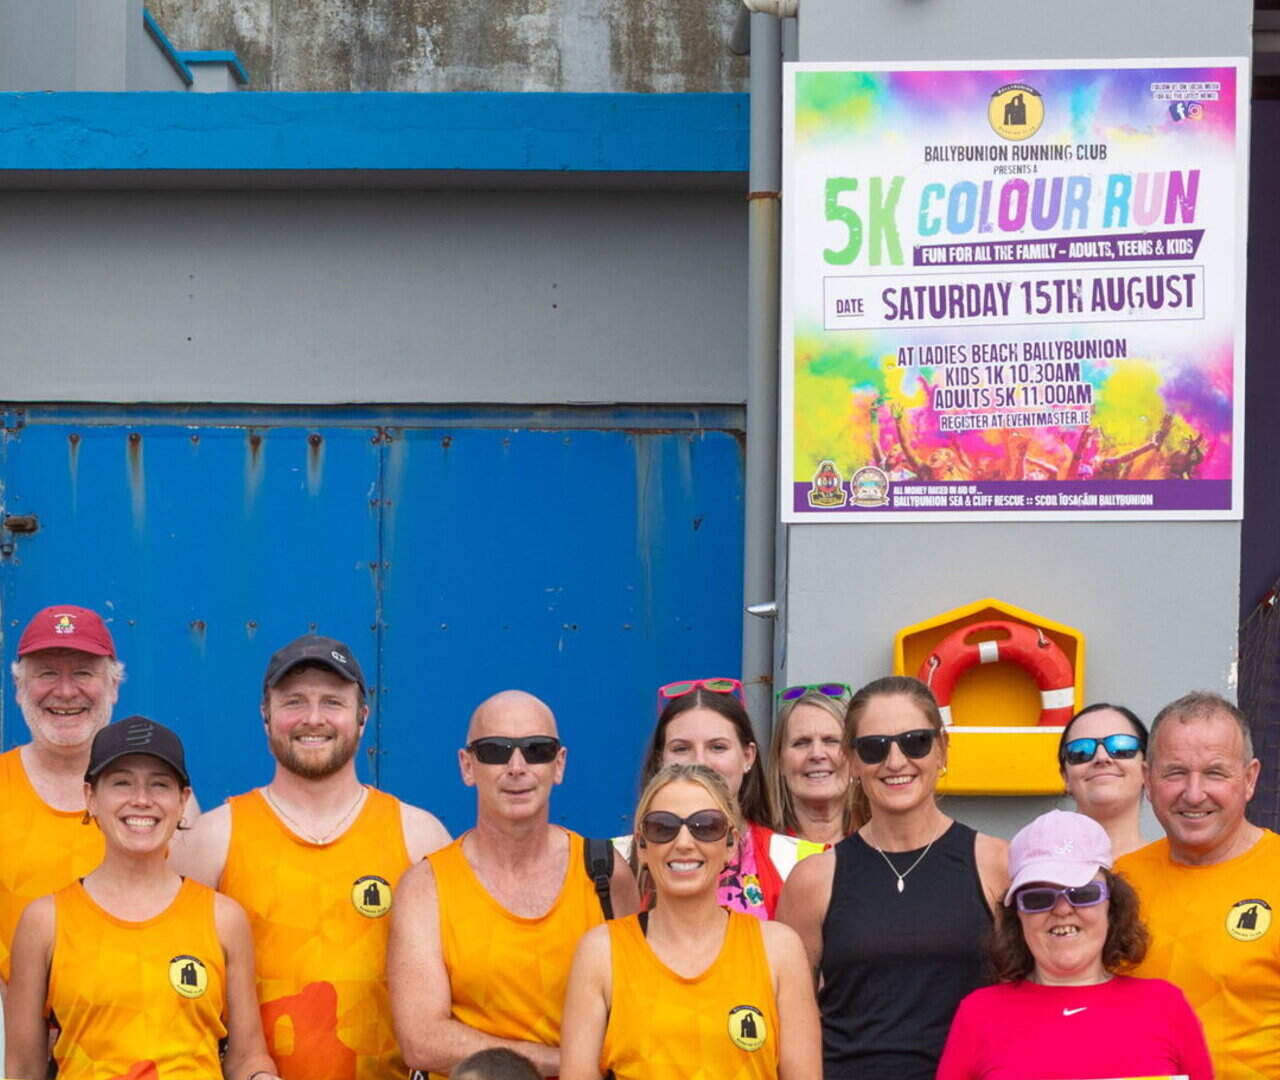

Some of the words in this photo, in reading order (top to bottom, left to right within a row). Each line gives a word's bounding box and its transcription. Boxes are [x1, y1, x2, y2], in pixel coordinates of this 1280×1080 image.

[924, 145, 1008, 162] BALLYBUNION
[1012, 144, 1073, 161] RUNNING
[1076, 144, 1108, 160] CLUB
[993, 164, 1032, 175] PRESENTS
[822, 175, 907, 266] 5K
[917, 175, 1093, 237] COLOUR
[1102, 169, 1201, 229] RUN
[922, 247, 947, 264] FUN
[949, 246, 973, 263] FOR
[974, 245, 992, 262] ALL
[993, 244, 1014, 261] THE
[1016, 243, 1057, 260] FAMILY
[1068, 241, 1116, 259] ADULTS,
[1117, 240, 1153, 257] TEENS
[1154, 239, 1165, 255] &
[1166, 239, 1194, 255] KIDS
[836, 298, 864, 314] DATE
[882, 282, 1013, 321] SATURDAY
[1020, 279, 1084, 315] 15TH
[1091, 273, 1196, 312] AUGUST
[898, 346, 914, 366] AT
[919, 345, 968, 365] LADIES
[971, 343, 1019, 363] BEACH
[1023, 339, 1127, 362] BALLYBUNION
[946, 366, 980, 387] KIDS
[985, 366, 1005, 385] 1K
[1010, 363, 1081, 384] 10.30AM
[935, 388, 991, 409] ADULTS
[995, 387, 1017, 407] 5K
[1021, 384, 1093, 405] 11.00AM
[941, 414, 989, 430] REGISTER
[991, 414, 1004, 428] AT
[1006, 411, 1089, 428] EVENTMASTER.IE
[893, 495, 948, 507] BALLYBUNION
[948, 495, 963, 506] SEA
[972, 495, 993, 506] CLIFF
[993, 495, 1025, 506] RESCUE
[1035, 494, 1058, 506] SCOIL
[1099, 494, 1154, 506] BALLYBUNION
